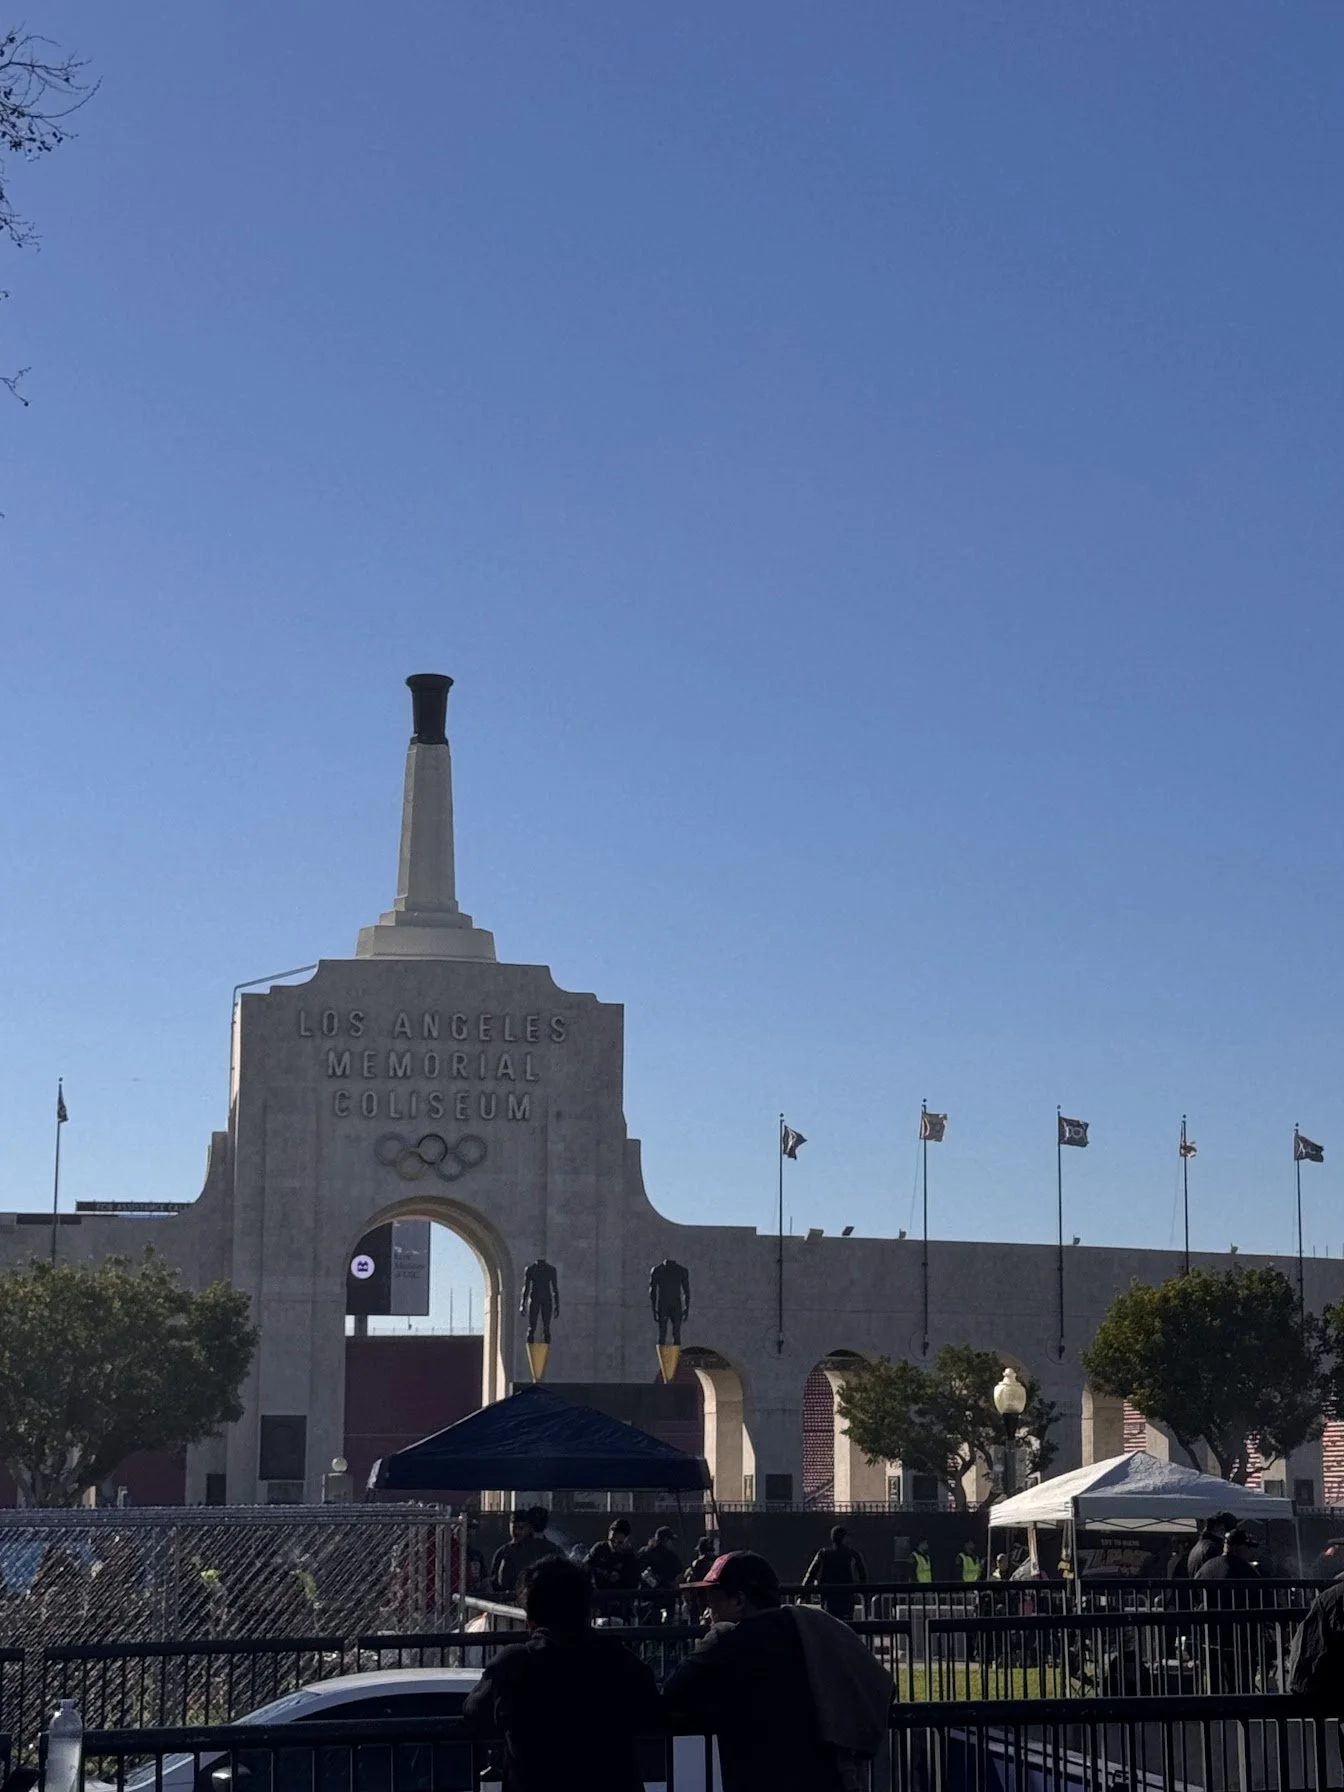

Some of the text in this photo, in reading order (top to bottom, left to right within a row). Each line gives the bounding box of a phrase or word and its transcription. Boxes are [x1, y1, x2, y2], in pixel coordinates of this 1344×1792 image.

[299, 1010, 567, 1043] LOS ANGELES
[327, 1050, 539, 1081] MEMORIAL
[334, 1089, 531, 1121] COLISEUM
